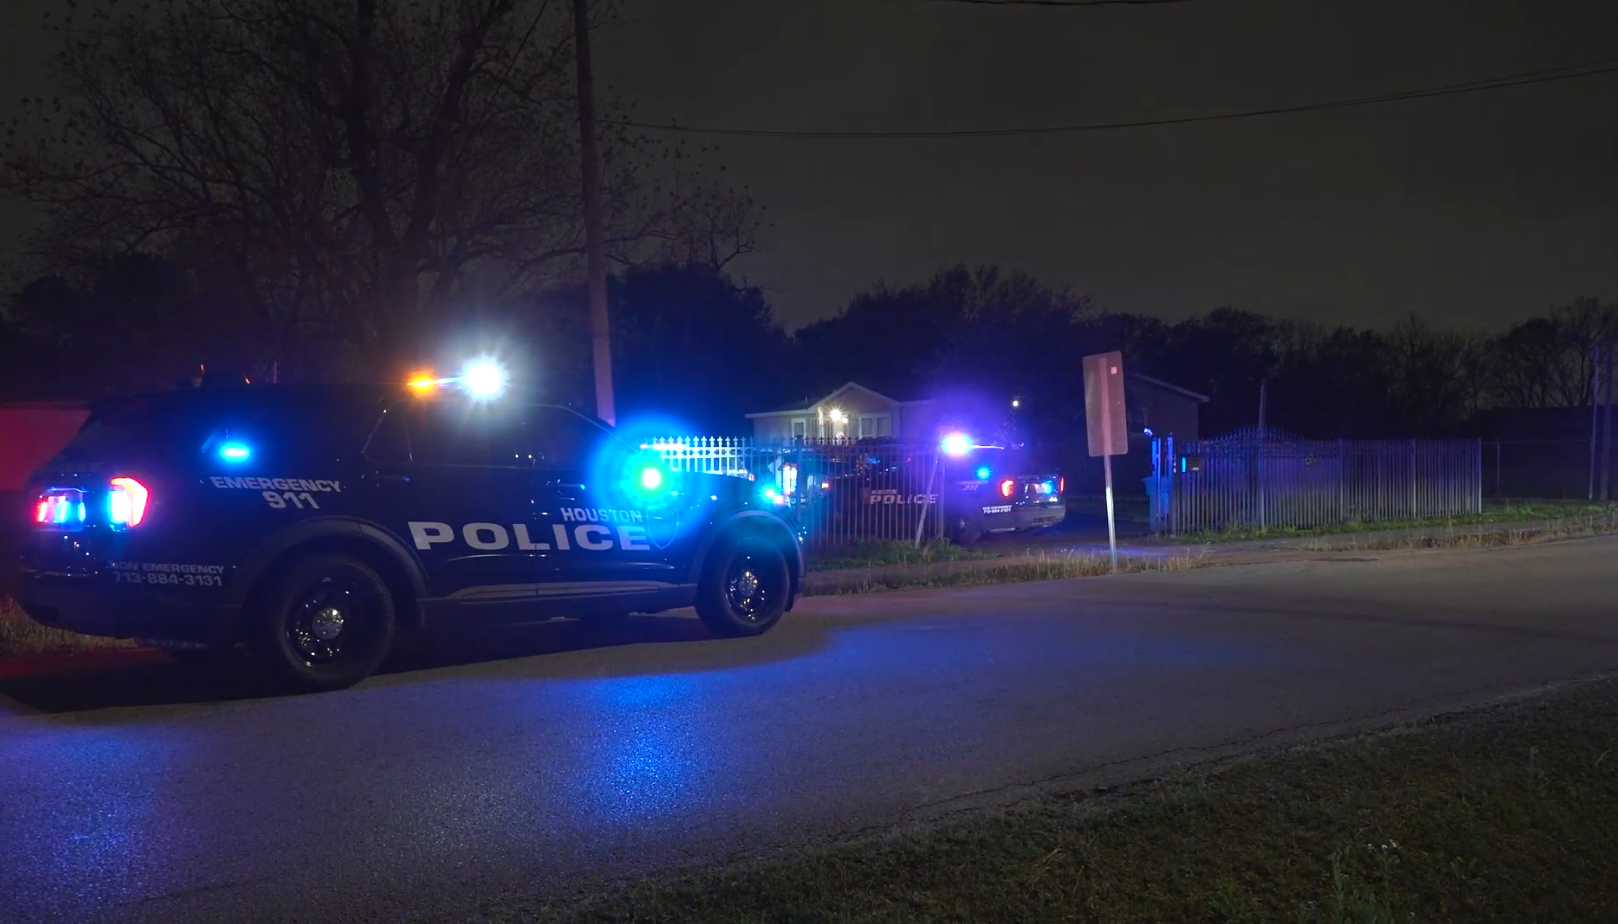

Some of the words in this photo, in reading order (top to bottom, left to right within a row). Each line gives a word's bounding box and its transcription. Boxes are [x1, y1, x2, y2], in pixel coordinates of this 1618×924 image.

[209, 475, 341, 493] EMERGENCY
[262, 490, 320, 510] 911
[870, 494, 939, 504] POLICE
[560, 507, 643, 523] HOUSTON
[407, 521, 651, 551] POLICE
[142, 562, 224, 574] EMERGENCY
[112, 571, 222, 587] 713-884-3131
